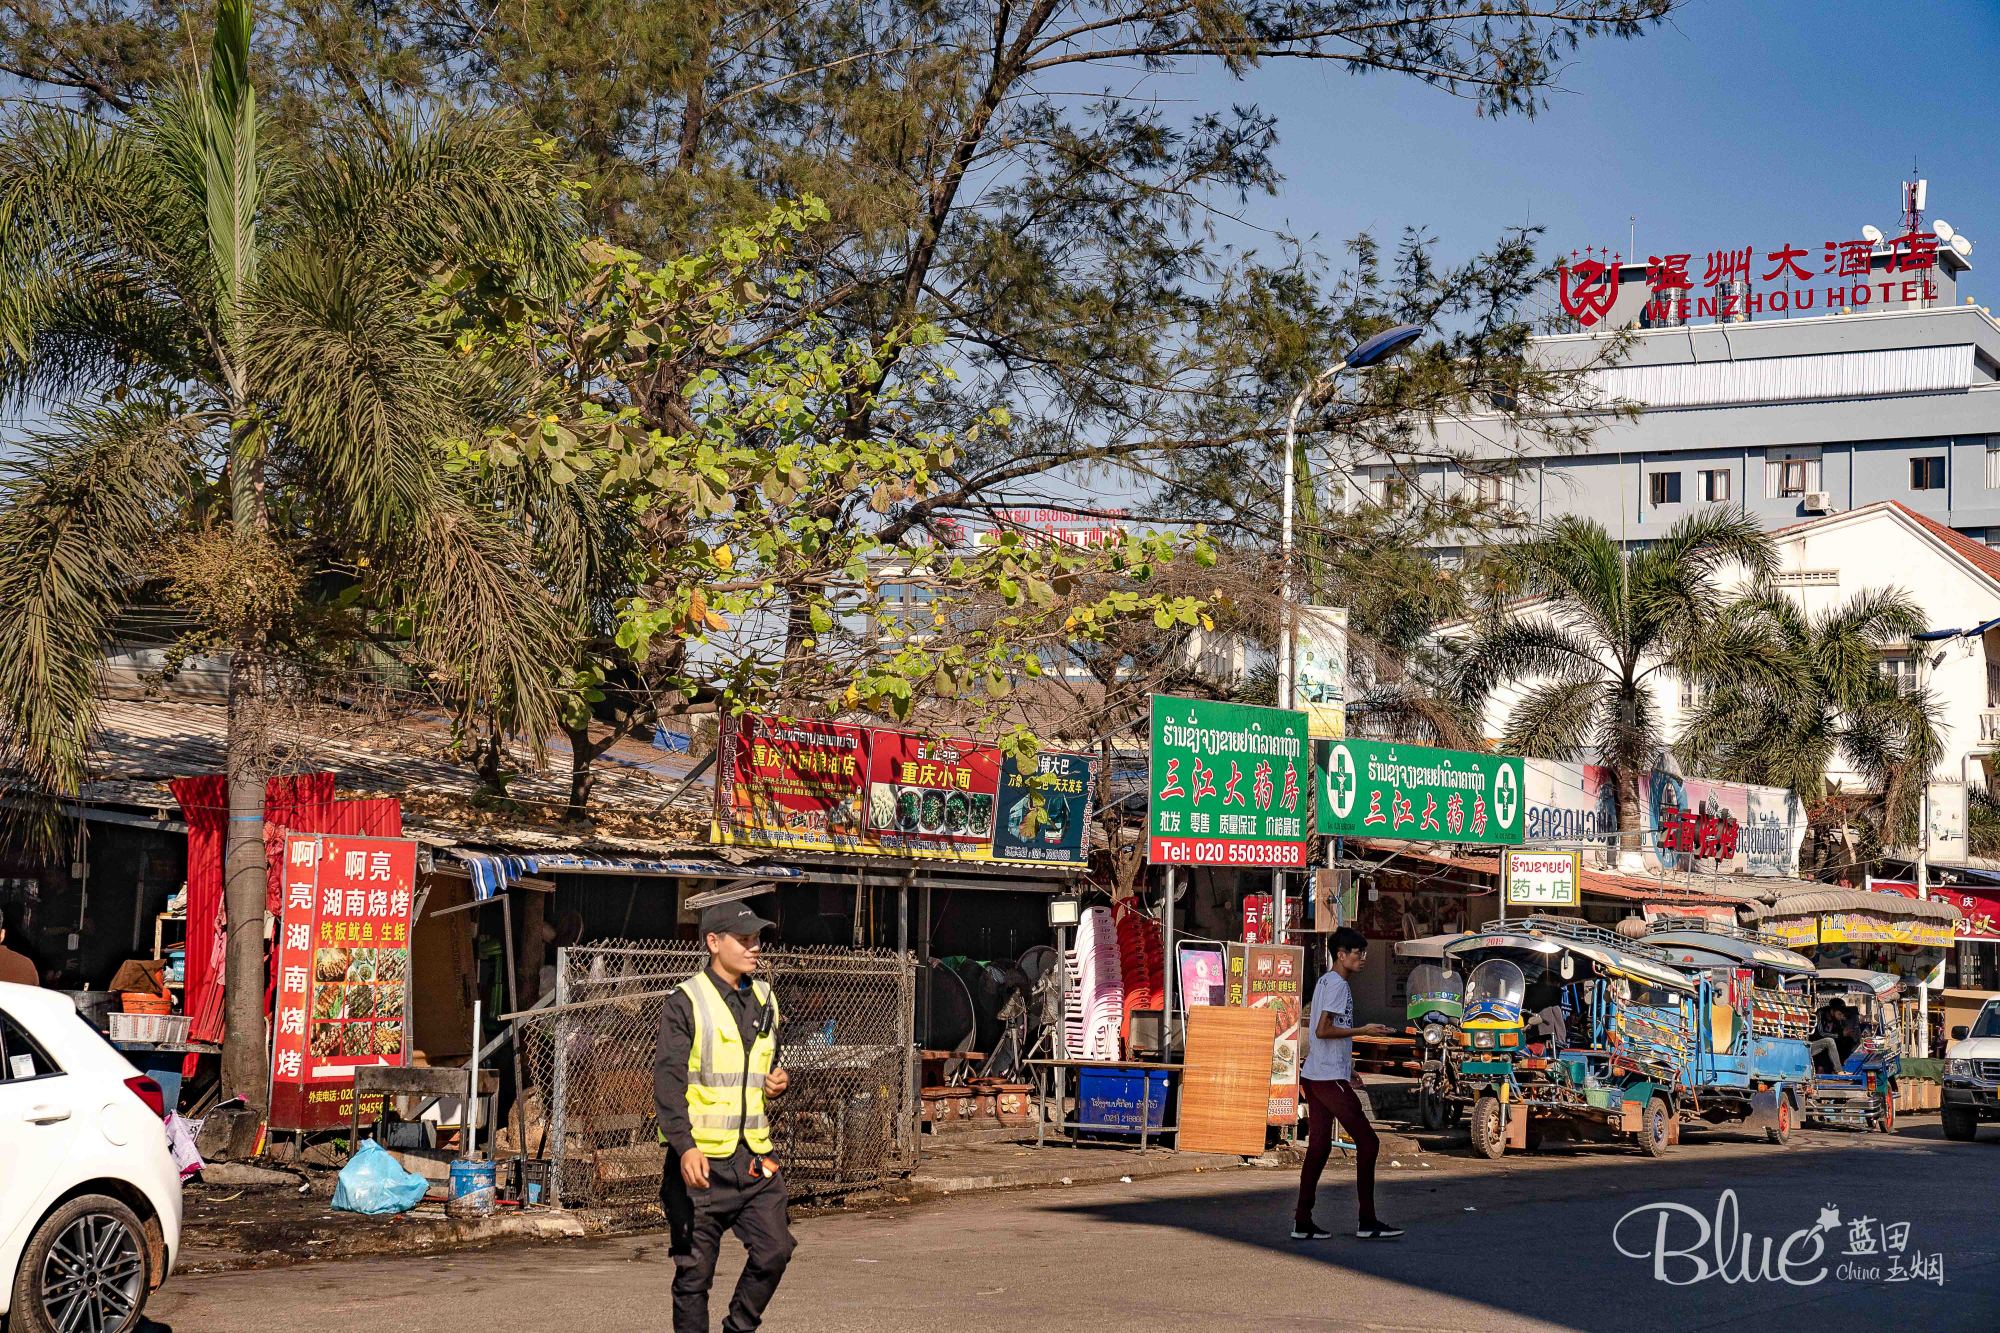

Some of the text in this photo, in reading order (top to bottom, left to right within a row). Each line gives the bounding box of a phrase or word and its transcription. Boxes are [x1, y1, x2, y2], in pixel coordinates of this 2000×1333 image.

[1645, 232, 1939, 291] 温州大酒店
[1645, 280, 1939, 321] WENZHOU HOTEL
[752, 744, 856, 777] 重庆小面粮油店
[901, 762, 973, 789] 重庆小面
[1159, 757, 1300, 813] 三江大药房
[1160, 811, 1301, 837] 批发 零售 质量保证 价格最低
[1364, 789, 1488, 838] 三江大药房
[345, 850, 392, 881] 啊亮
[1160, 841, 1299, 863] Tel: 020 55033858
[1512, 856, 1571, 873] ຮ້ານຂາຍຢາ
[322, 888, 410, 918] 湖南烧烤
[1962, 896, 1974, 908] 庆
[277, 840, 315, 1078] 啊亮湖南烧烤
[1257, 954, 1294, 977] 啊亮
[1231, 957, 1243, 1004] 啊亮
